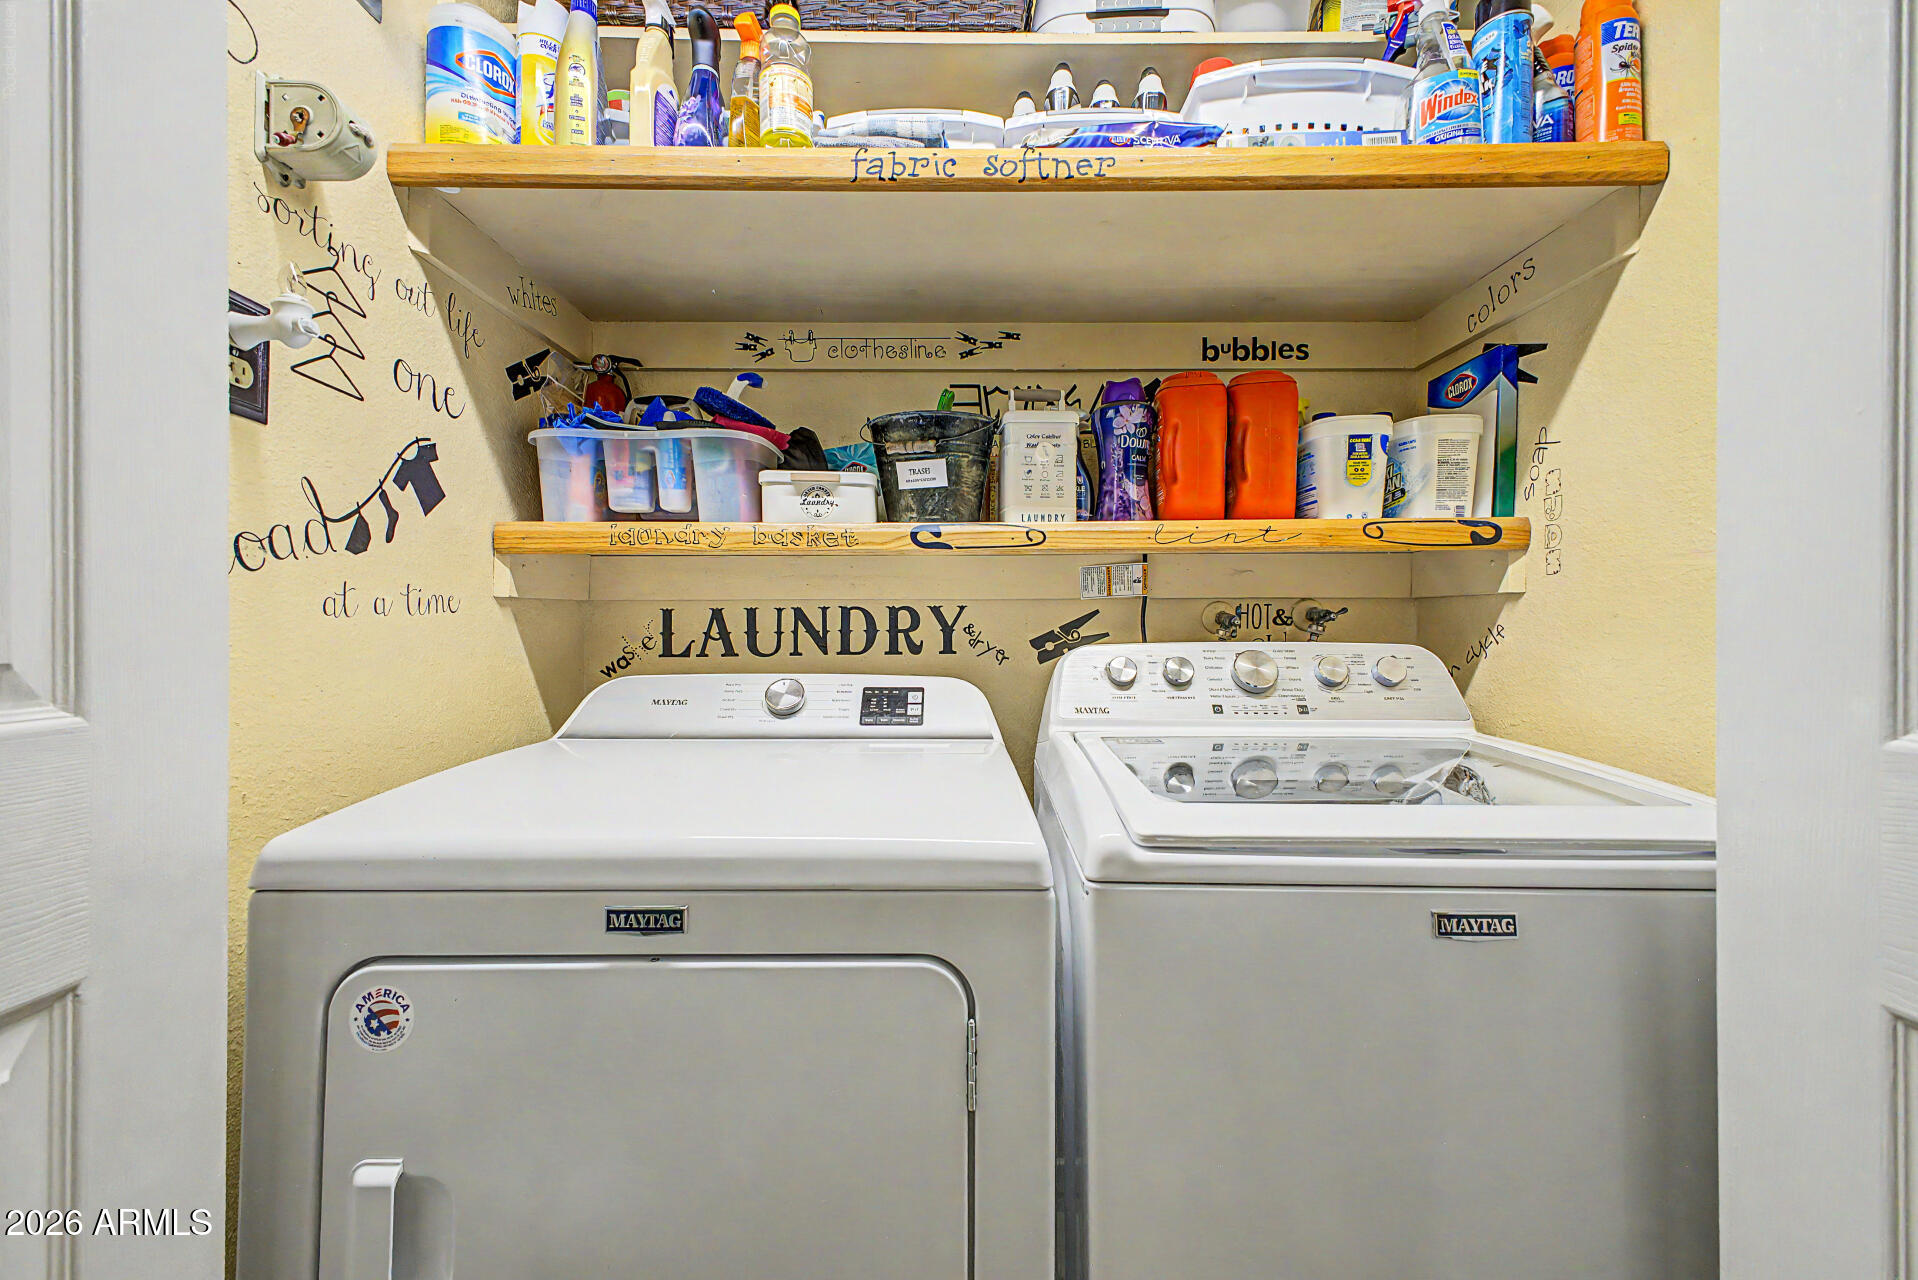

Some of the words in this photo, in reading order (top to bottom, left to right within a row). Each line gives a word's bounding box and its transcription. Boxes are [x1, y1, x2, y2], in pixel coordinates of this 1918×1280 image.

[463, 53, 516, 96] CLOROX
[1420, 87, 1479, 129] Windex
[849, 147, 957, 183] fabric
[982, 145, 1116, 183] softner
[253, 181, 382, 300] sorting
[506, 276, 559, 316] whites
[1467, 257, 1536, 333] colors
[395, 277, 436, 318] out
[446, 292, 486, 359] life
[827, 338, 947, 360] clothesline
[1202, 337, 1310, 362] bubbles
[393, 358, 466, 419] one
[1447, 377, 1474, 399] CLOROX
[1524, 426, 1561, 502] soap
[229, 475, 337, 574] oad
[609, 523, 731, 549] laundry
[752, 524, 860, 548] basket
[1021, 514, 1066, 522] LAUNDRY
[1154, 523, 1303, 544] lint
[322, 580, 359, 618] at
[373, 594, 394, 617] a
[400, 583, 461, 617] time
[599, 619, 658, 679] washer
[658, 605, 967, 658] LAUNDRY
[1465, 624, 1505, 665] cycle
[651, 698, 689, 706] MAYTAG
[1074, 706, 1111, 715] MAYTAG
[608, 913, 682, 929] MAYTAG
[1439, 918, 1515, 933] MAYTAG
[355, 988, 411, 1013] AMERICA
